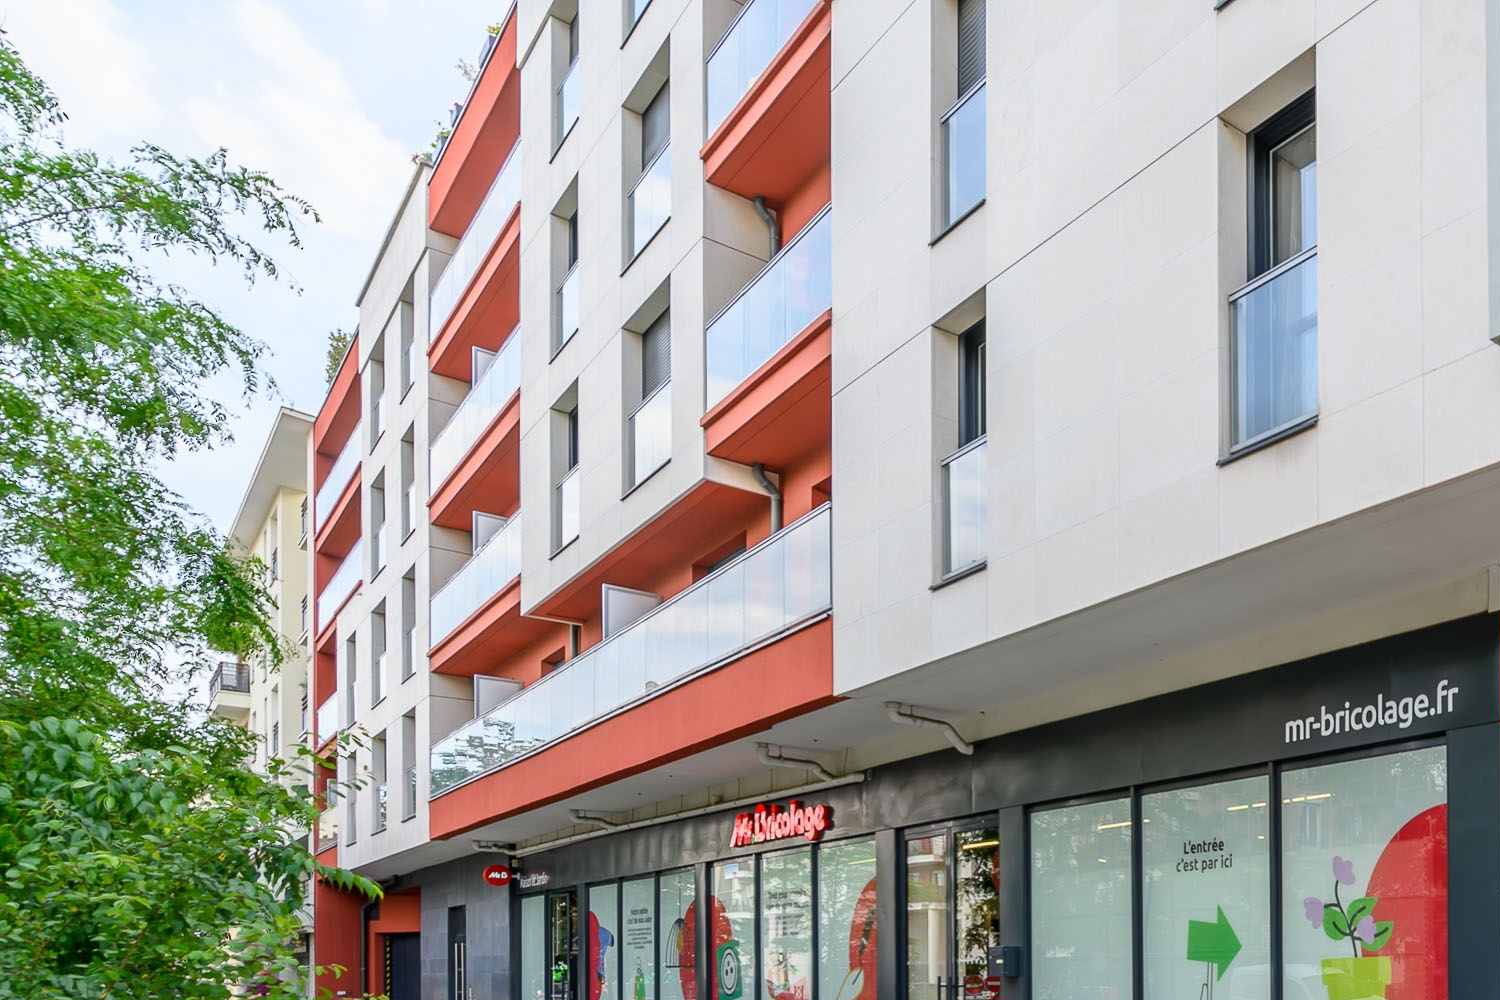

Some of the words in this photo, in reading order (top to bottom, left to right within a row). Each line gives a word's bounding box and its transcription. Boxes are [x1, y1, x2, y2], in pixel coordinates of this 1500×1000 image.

[1285, 679, 1459, 743] mr-bricolage.fr
[1183, 837, 1225, 855] L'entrée
[1176, 858, 1199, 873] c'est
[1201, 858, 1219, 873] par
[1220, 853, 1233, 869] ici
